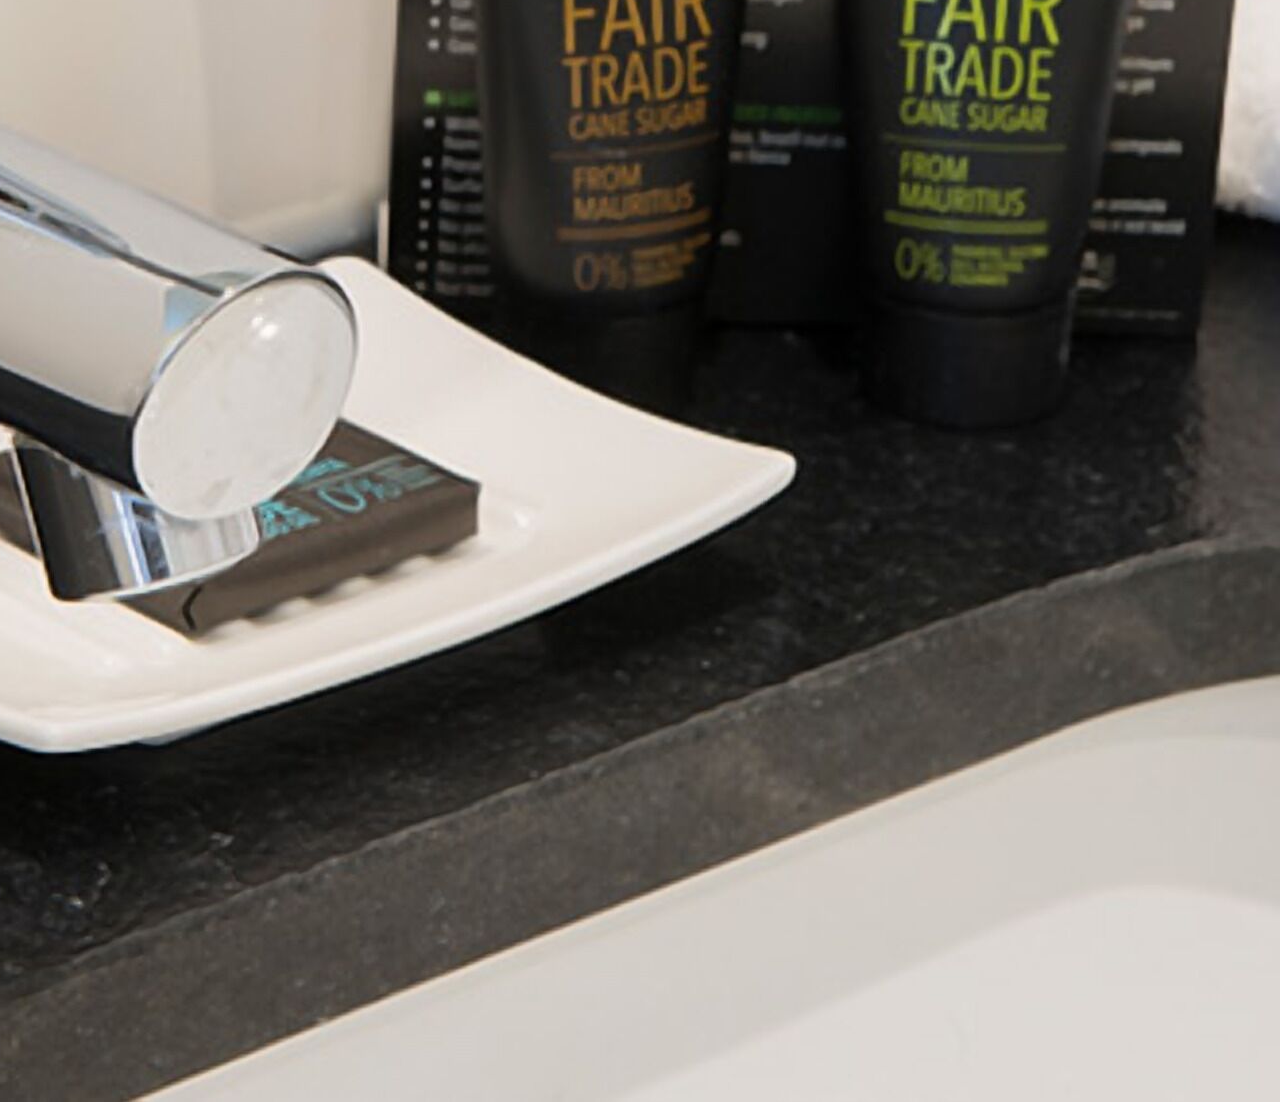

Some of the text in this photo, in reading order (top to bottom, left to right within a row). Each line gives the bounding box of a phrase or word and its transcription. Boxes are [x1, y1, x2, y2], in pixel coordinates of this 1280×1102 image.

[561, 41, 712, 109] TRADE
[899, 39, 1056, 102] TRADE
[569, 108, 630, 142] CANE
[635, 99, 707, 136] SUGAR
[899, 98, 1049, 133] CANE SUGAR
[573, 163, 643, 194] FROM
[899, 151, 969, 184] FROM
[572, 182, 694, 221] MAURITIUS
[899, 183, 1027, 218] MAURITIUS
[574, 251, 628, 292] 0%
[894, 237, 946, 284] 0%
